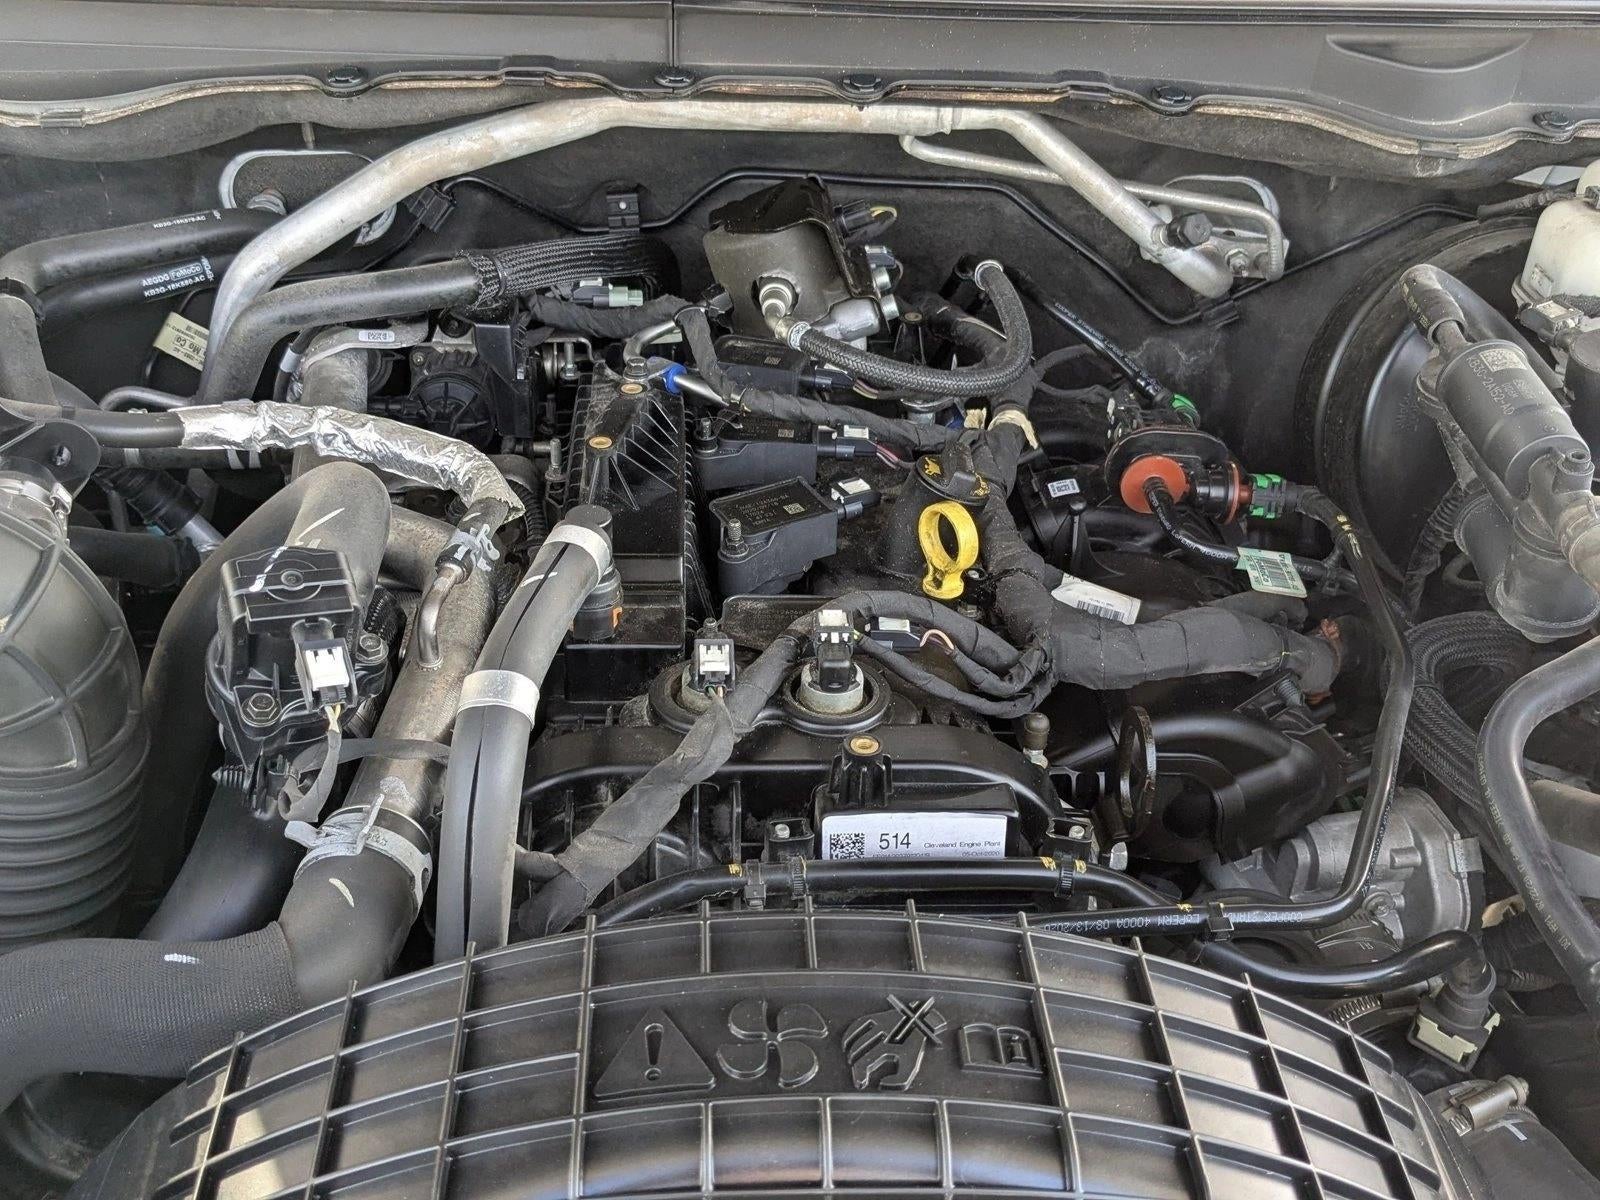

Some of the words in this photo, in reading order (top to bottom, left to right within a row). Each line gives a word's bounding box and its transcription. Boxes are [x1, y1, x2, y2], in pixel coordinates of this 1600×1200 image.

[879, 832, 912, 850] 514
[923, 841, 957, 849] Cleveland
[1116, 917, 1151, 929] 4000A
